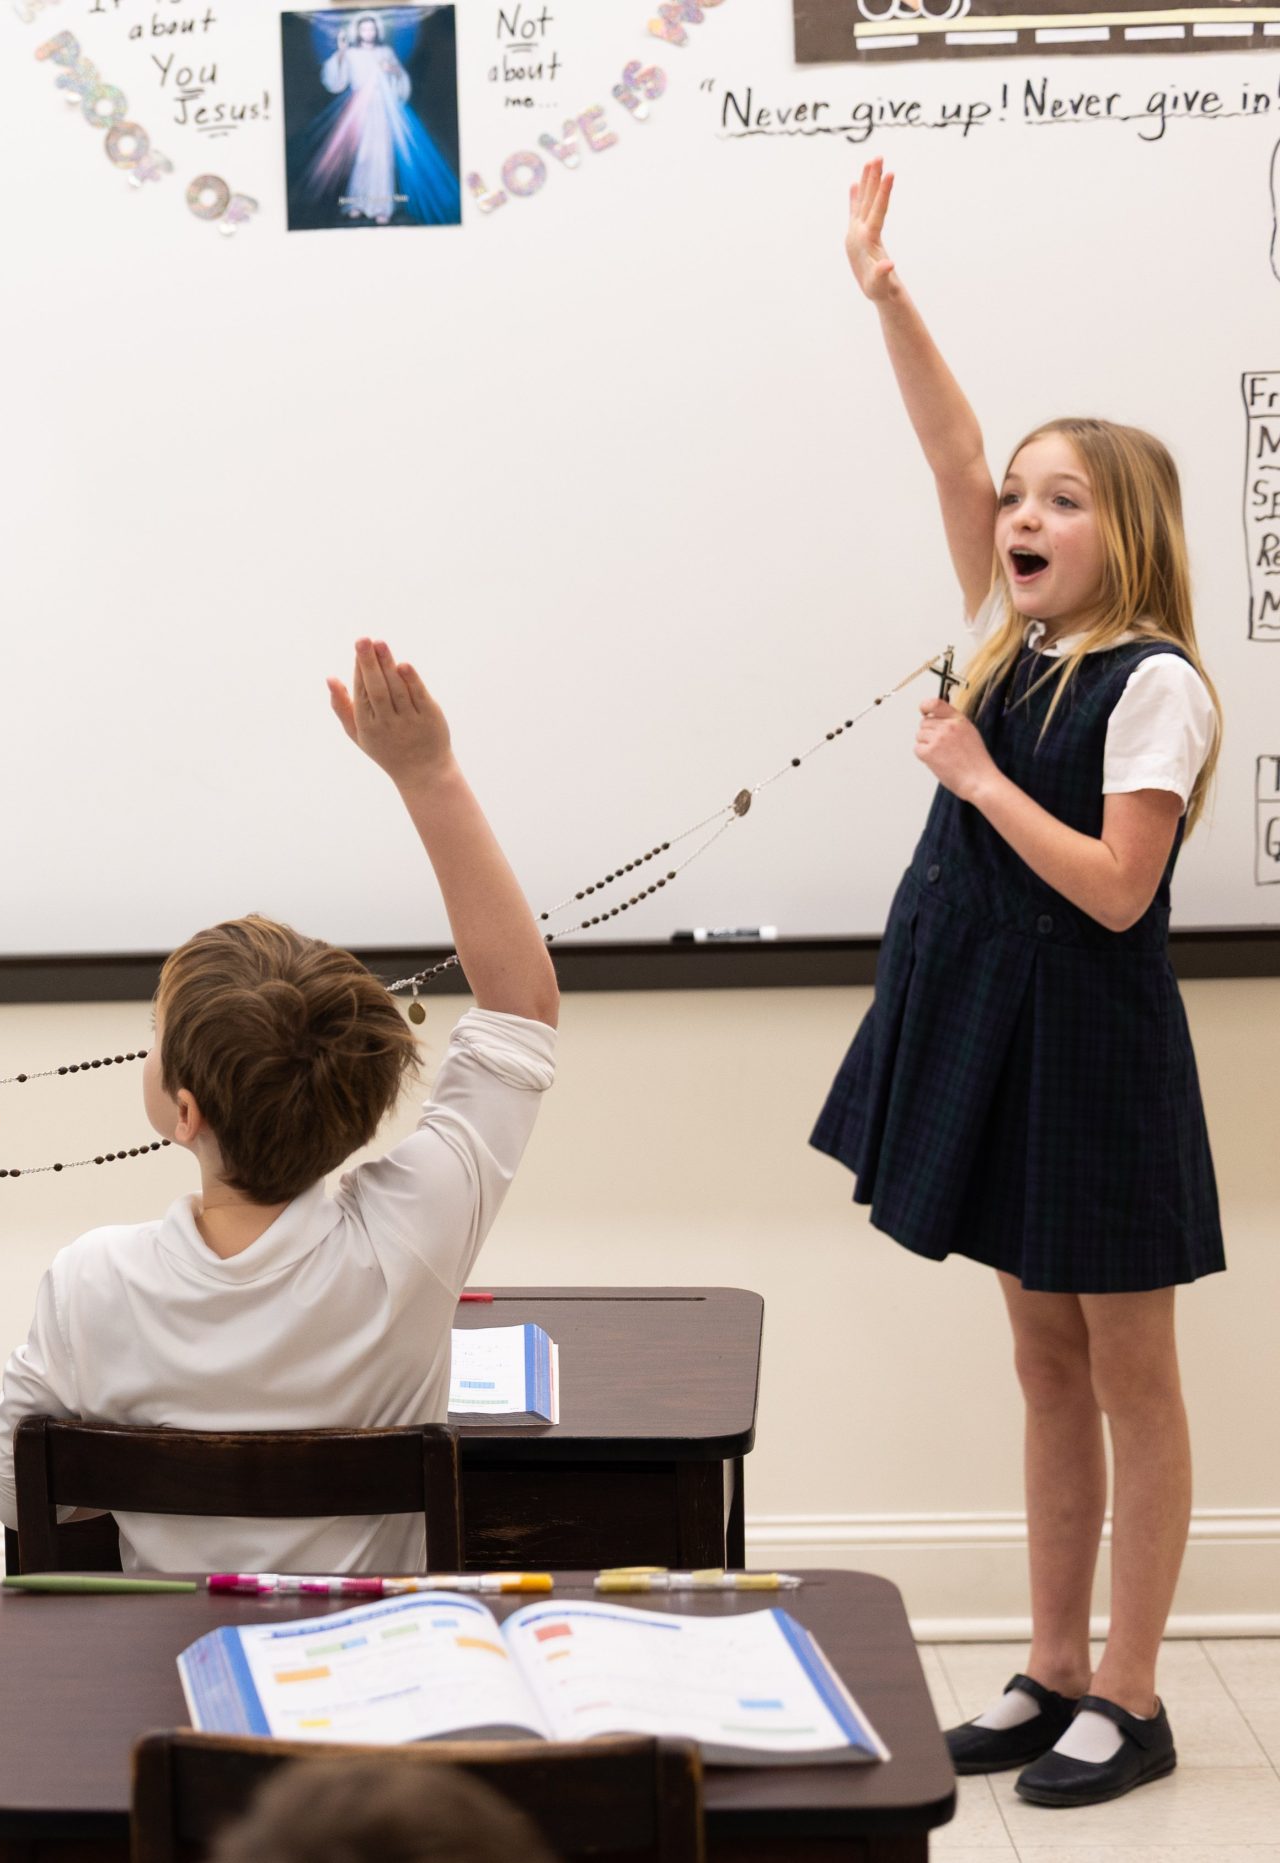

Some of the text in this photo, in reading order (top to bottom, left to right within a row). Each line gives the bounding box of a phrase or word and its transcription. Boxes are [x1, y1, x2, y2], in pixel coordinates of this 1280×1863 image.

[128, 9, 217, 41] about
[496, 4, 554, 41] Not
[150, 52, 217, 89] You
[487, 51, 563, 84] about
[173, 91, 271, 126] Jesus!
[847, 96, 921, 144] give
[940, 82, 1009, 138] up!
[1023, 77, 1122, 120] Never
[1137, 84, 1221, 141] give
